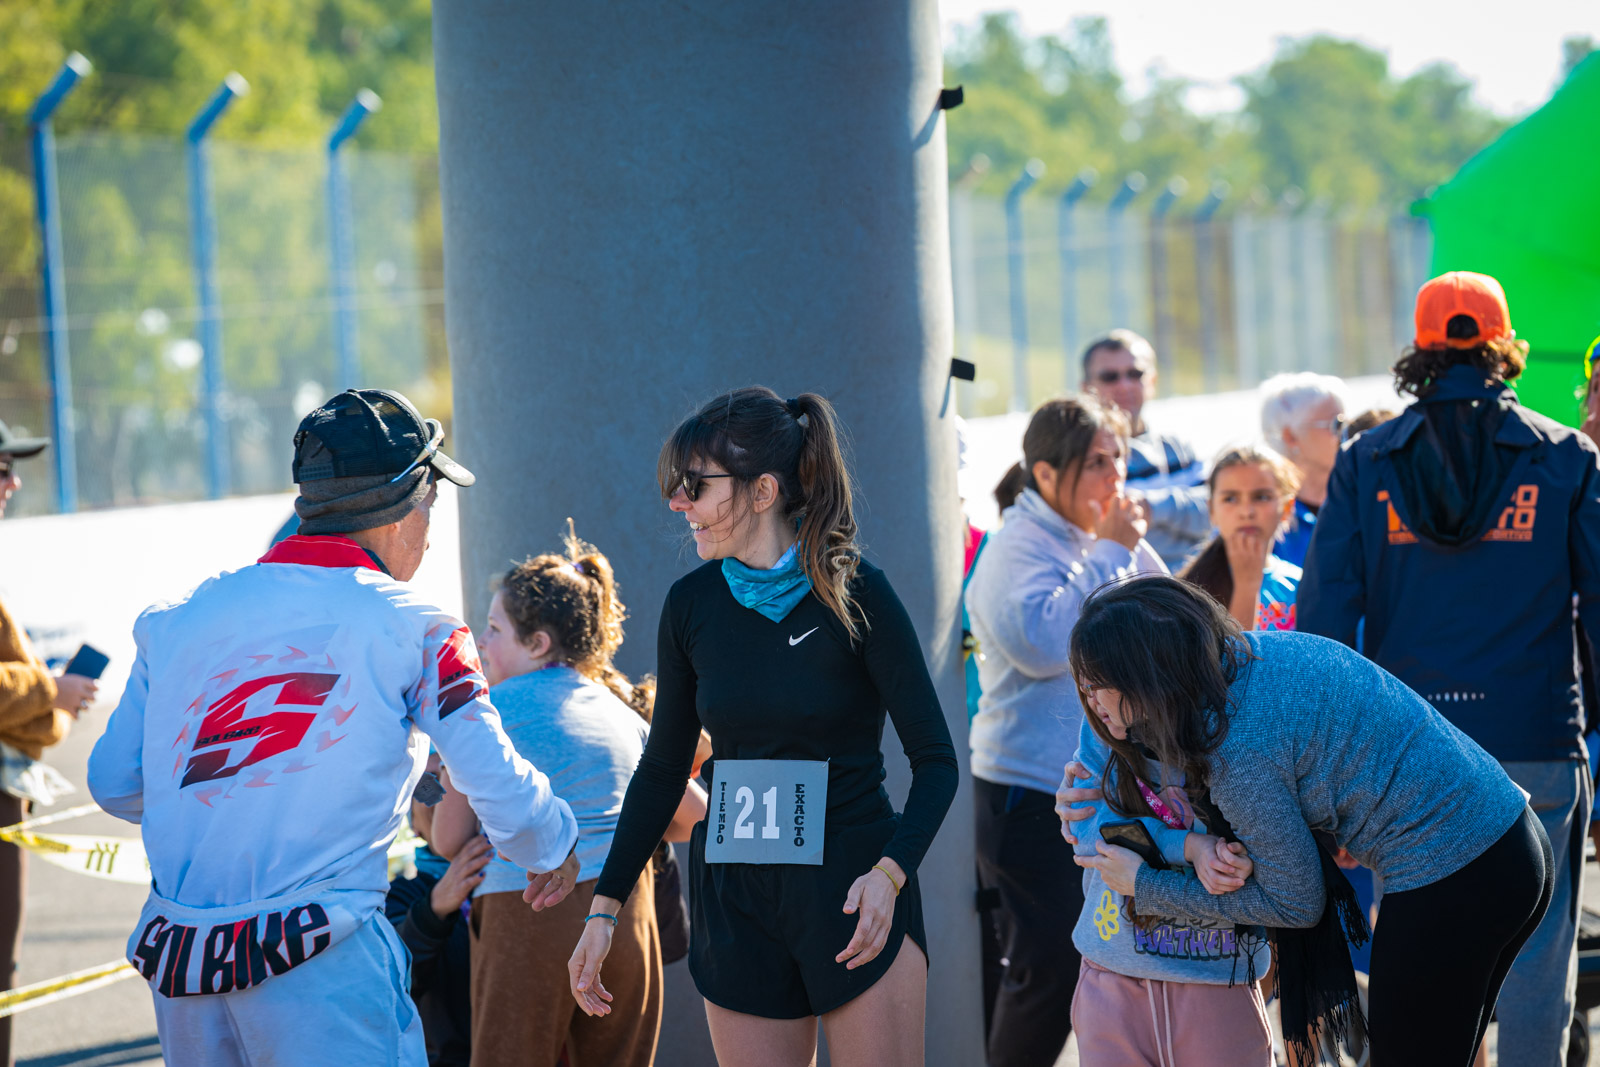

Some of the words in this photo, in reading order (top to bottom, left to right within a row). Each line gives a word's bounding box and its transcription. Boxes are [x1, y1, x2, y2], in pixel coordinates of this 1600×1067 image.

[716, 781, 727, 845] TIEMPO
[733, 786, 780, 839] 21
[793, 783, 806, 847] EXACTO
